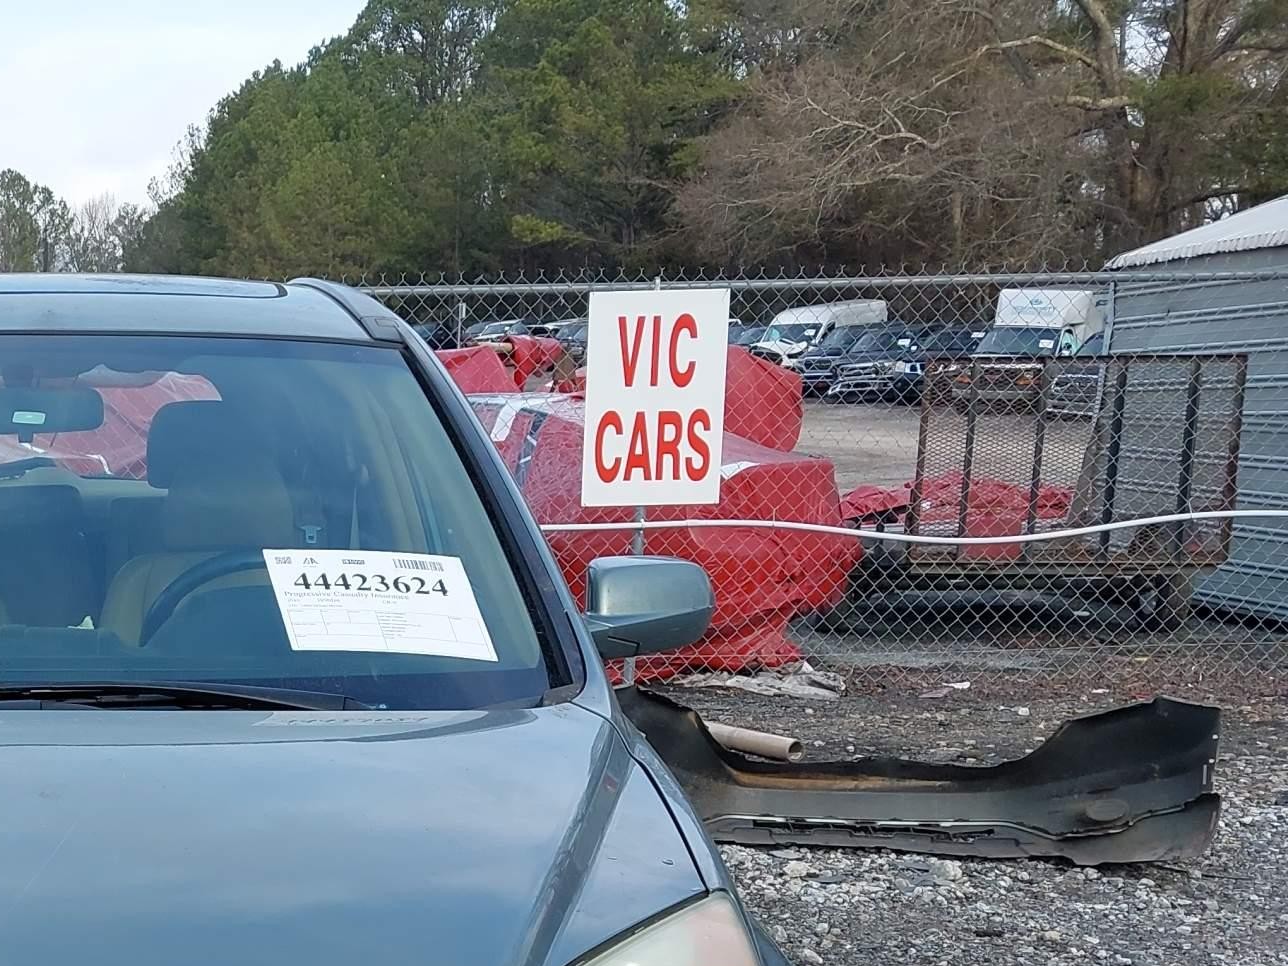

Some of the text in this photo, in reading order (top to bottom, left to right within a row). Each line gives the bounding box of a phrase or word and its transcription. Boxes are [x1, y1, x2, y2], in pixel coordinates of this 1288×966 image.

[618, 313, 698, 388] VIC
[594, 408, 711, 484] CARS
[294, 572, 449, 597] 44423624
